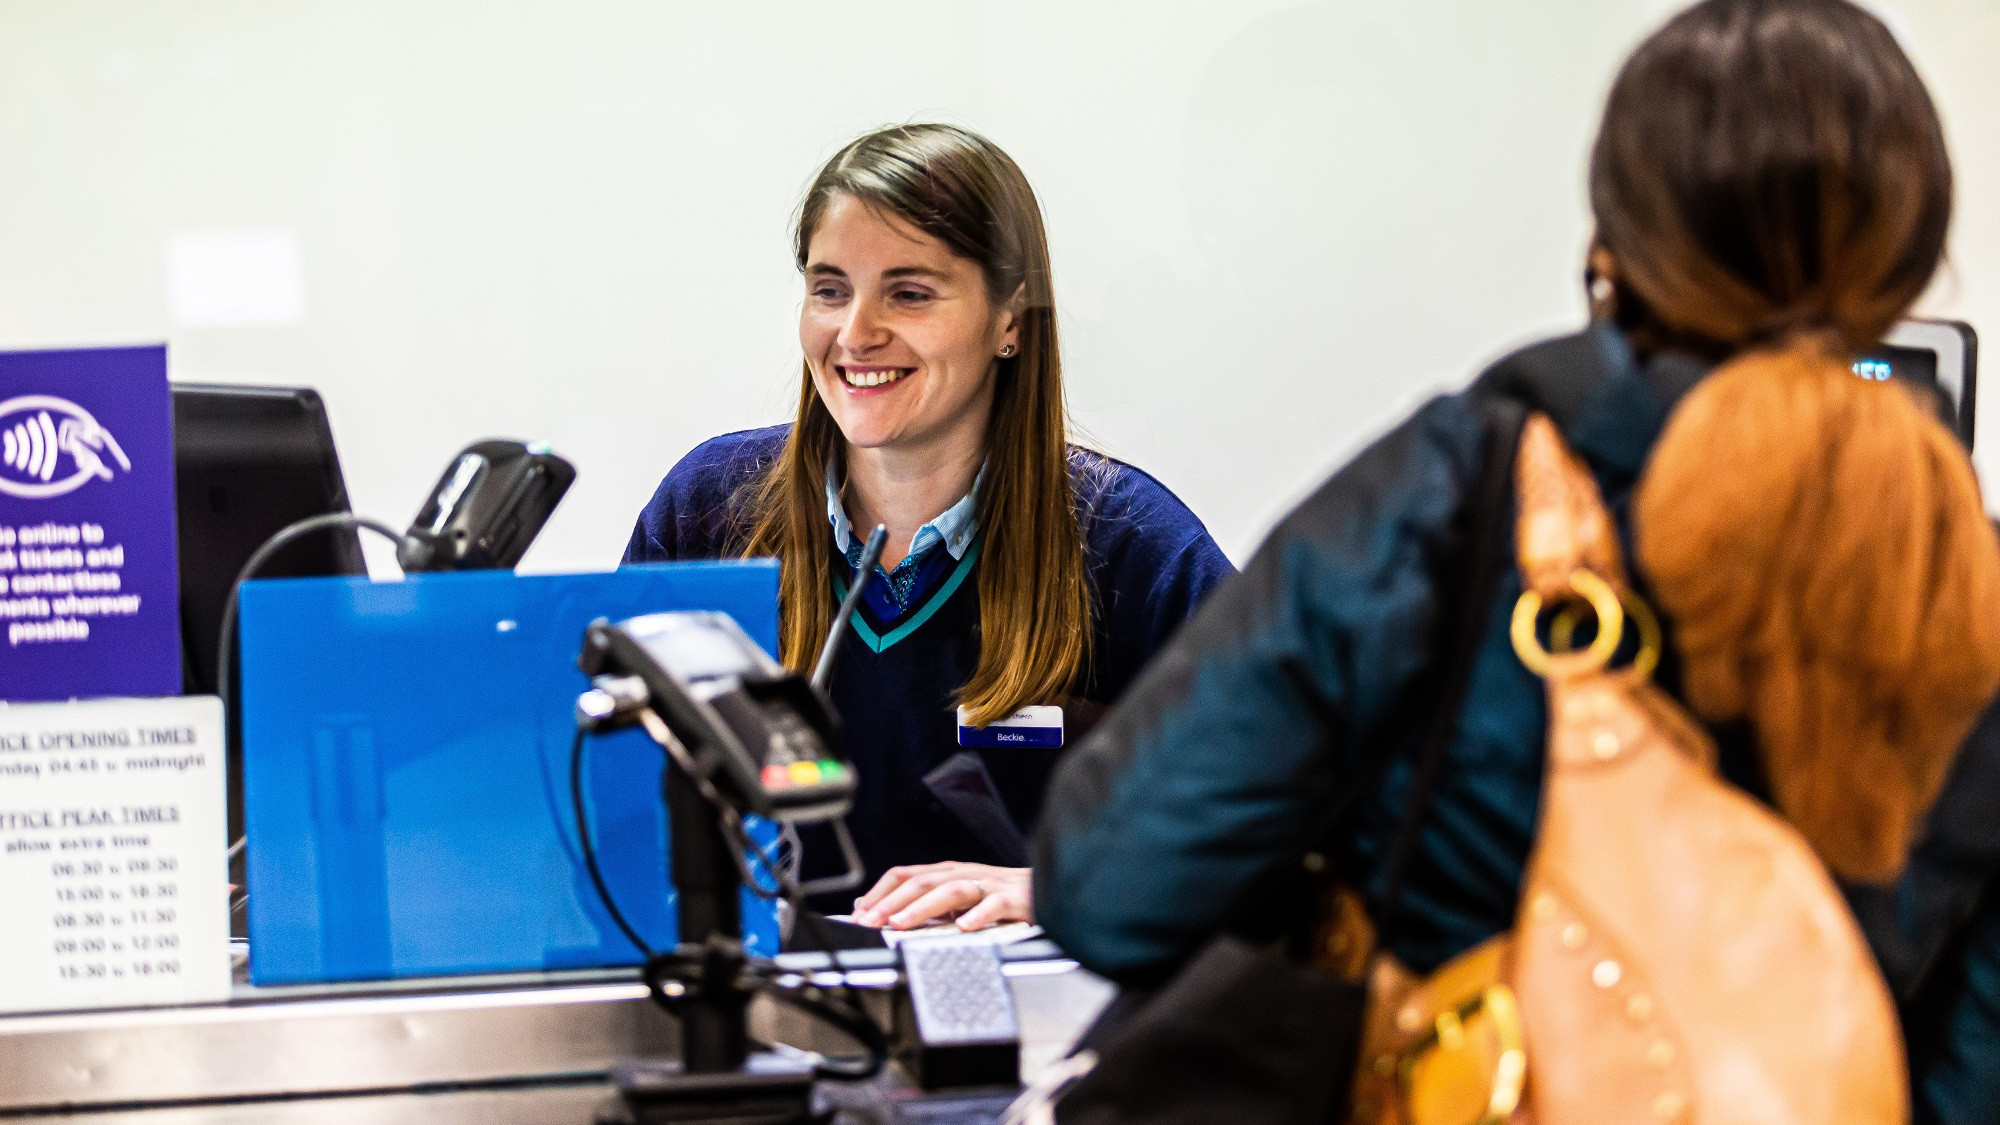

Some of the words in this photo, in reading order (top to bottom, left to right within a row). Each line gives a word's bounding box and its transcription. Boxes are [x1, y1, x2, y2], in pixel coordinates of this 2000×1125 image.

[18, 523, 80, 546] online
[81, 522, 104, 543] to
[20, 546, 84, 569] tickets
[86, 544, 124, 567] and
[11, 571, 121, 593] contactless
[52, 594, 141, 616] wherever
[9, 618, 89, 645] possible
[39, 731, 130, 750] OPENING
[136, 726, 198, 746] TIMES
[997, 733, 1025, 741] Beckie
[125, 754, 206, 773] midnight
[61, 808, 113, 826] PEAK
[121, 805, 180, 824] TIMES
[5, 837, 51, 853] allow
[59, 837, 105, 850] extra
[111, 834, 150, 848] time
